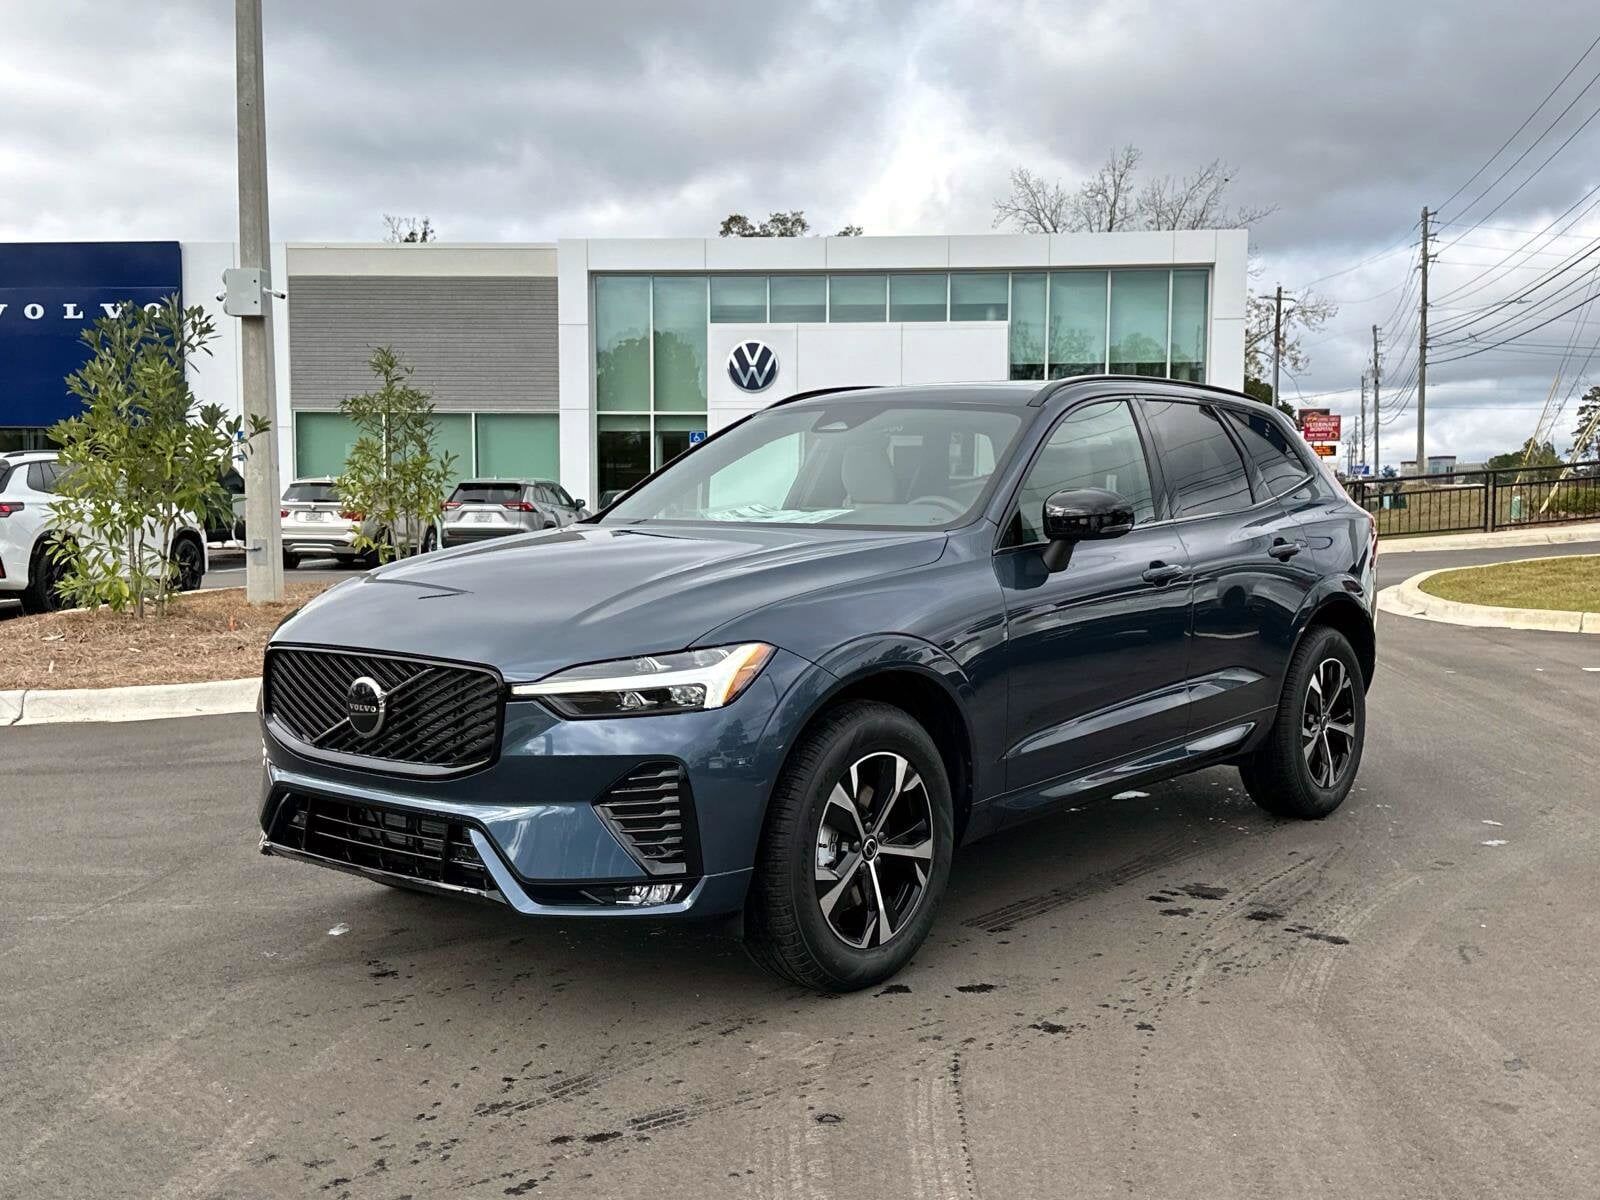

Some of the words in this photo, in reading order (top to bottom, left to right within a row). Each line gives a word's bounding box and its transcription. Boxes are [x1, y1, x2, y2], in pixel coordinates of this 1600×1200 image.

[0, 303, 162, 319] OLVO
[729, 341, 777, 390] VW
[349, 702, 377, 713] VOLVO
